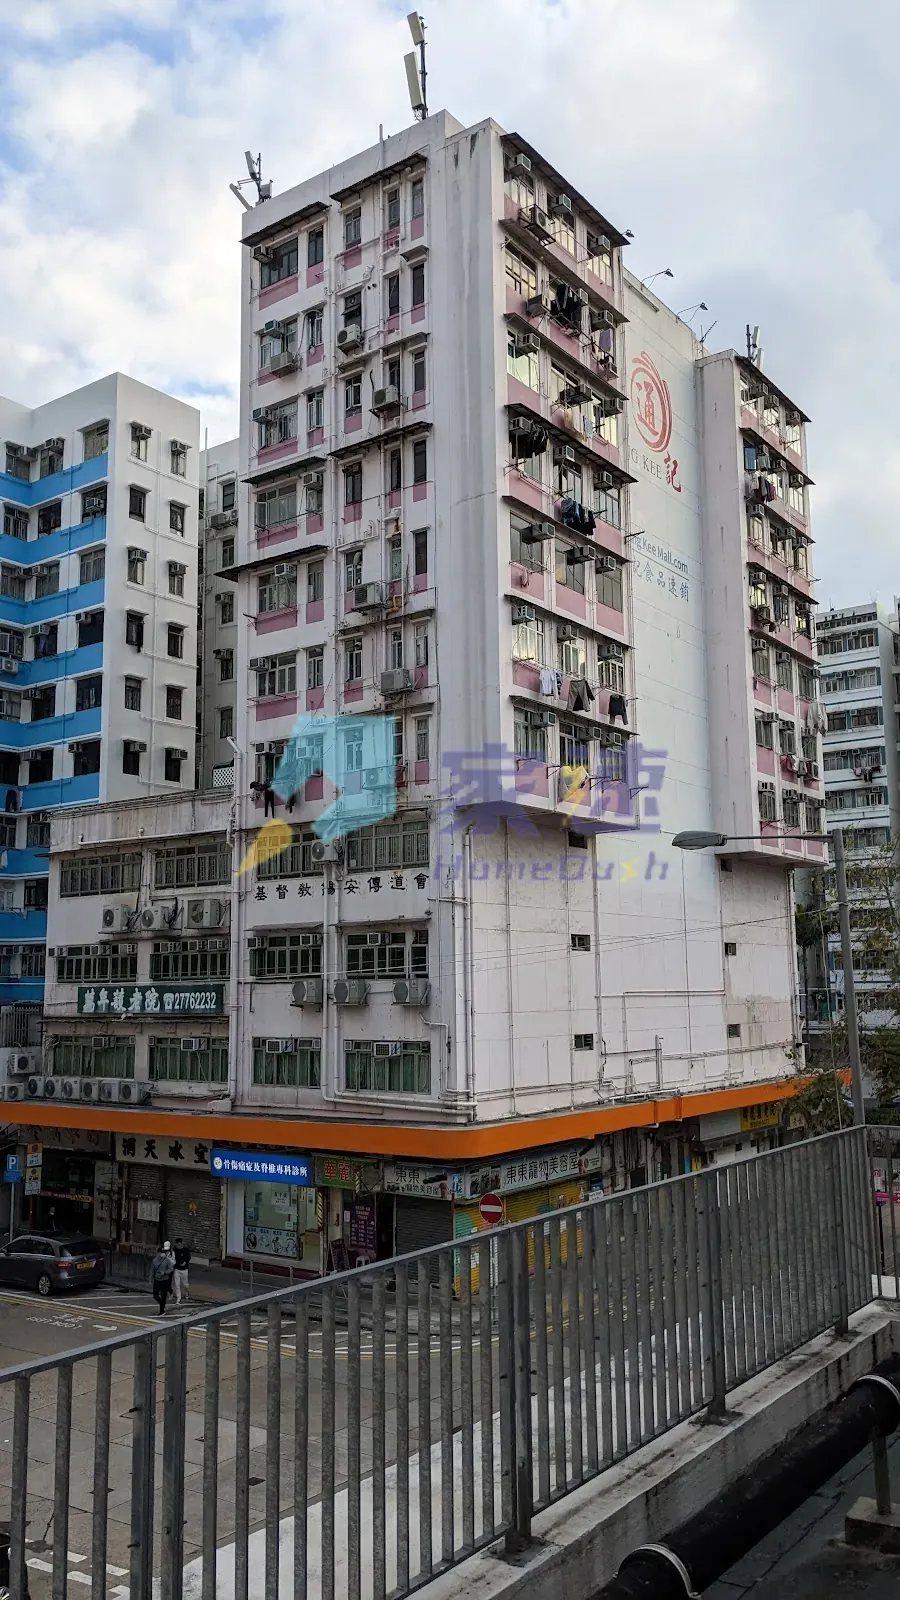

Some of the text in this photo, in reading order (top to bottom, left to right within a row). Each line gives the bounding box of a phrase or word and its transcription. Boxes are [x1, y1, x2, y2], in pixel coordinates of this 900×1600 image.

[635, 380, 660, 437] 通
[642, 454, 663, 480] KEE
[663, 450, 682, 493] 記
[174, 991, 217, 1009] 27762232
[8, 1156, 17, 1170] P
[223, 1158, 308, 1178] 骨傷痛症及脊椎專科診所
[324, 1163, 363, 1183] 華麗
[506, 1150, 579, 1185] 東東寵物美容屋
